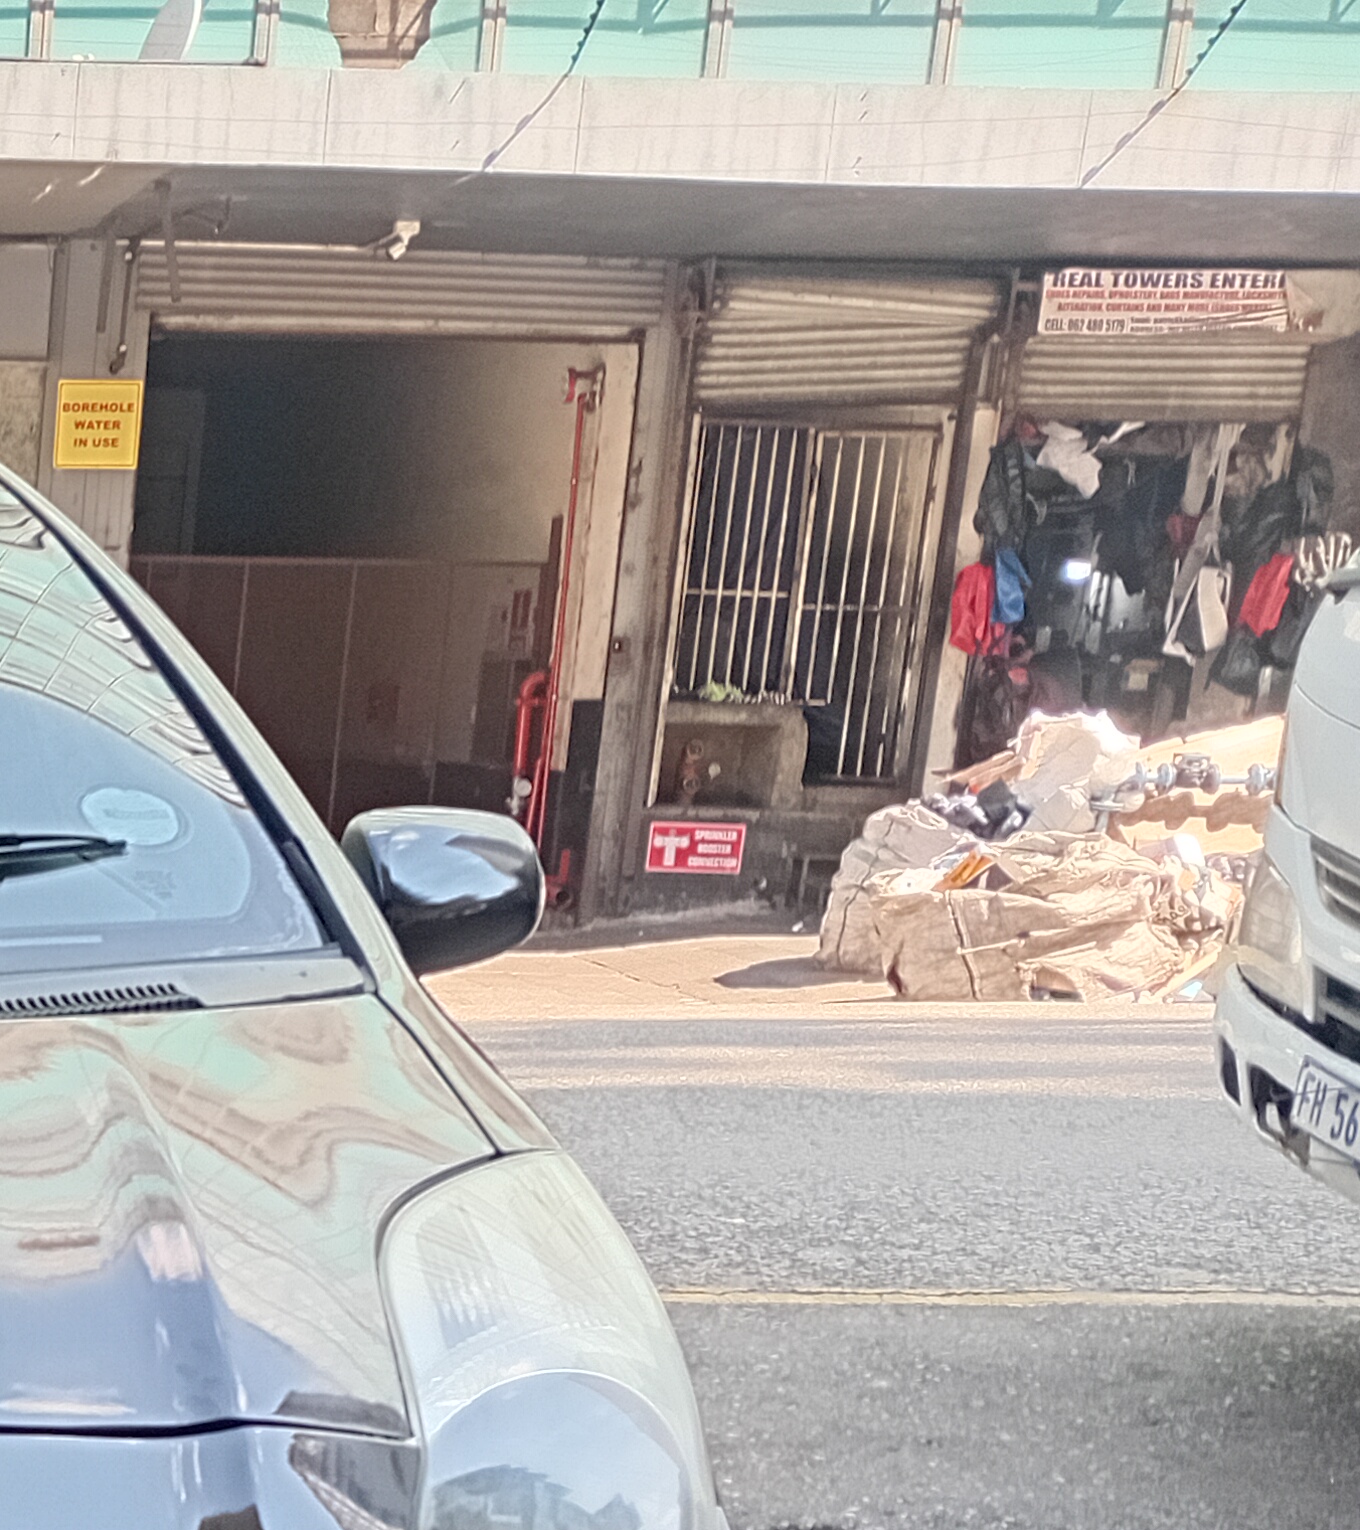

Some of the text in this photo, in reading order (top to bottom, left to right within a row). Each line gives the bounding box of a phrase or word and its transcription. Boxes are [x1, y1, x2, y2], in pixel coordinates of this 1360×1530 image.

[1052, 271, 1105, 288] REAL
[1111, 271, 1204, 289] TOWERS
[62, 402, 135, 413] BOREHOLE
[73, 420, 121, 431] WATER
[73, 438, 120, 448] IN USE
[1296, 1070, 1360, 1148] FH 56
